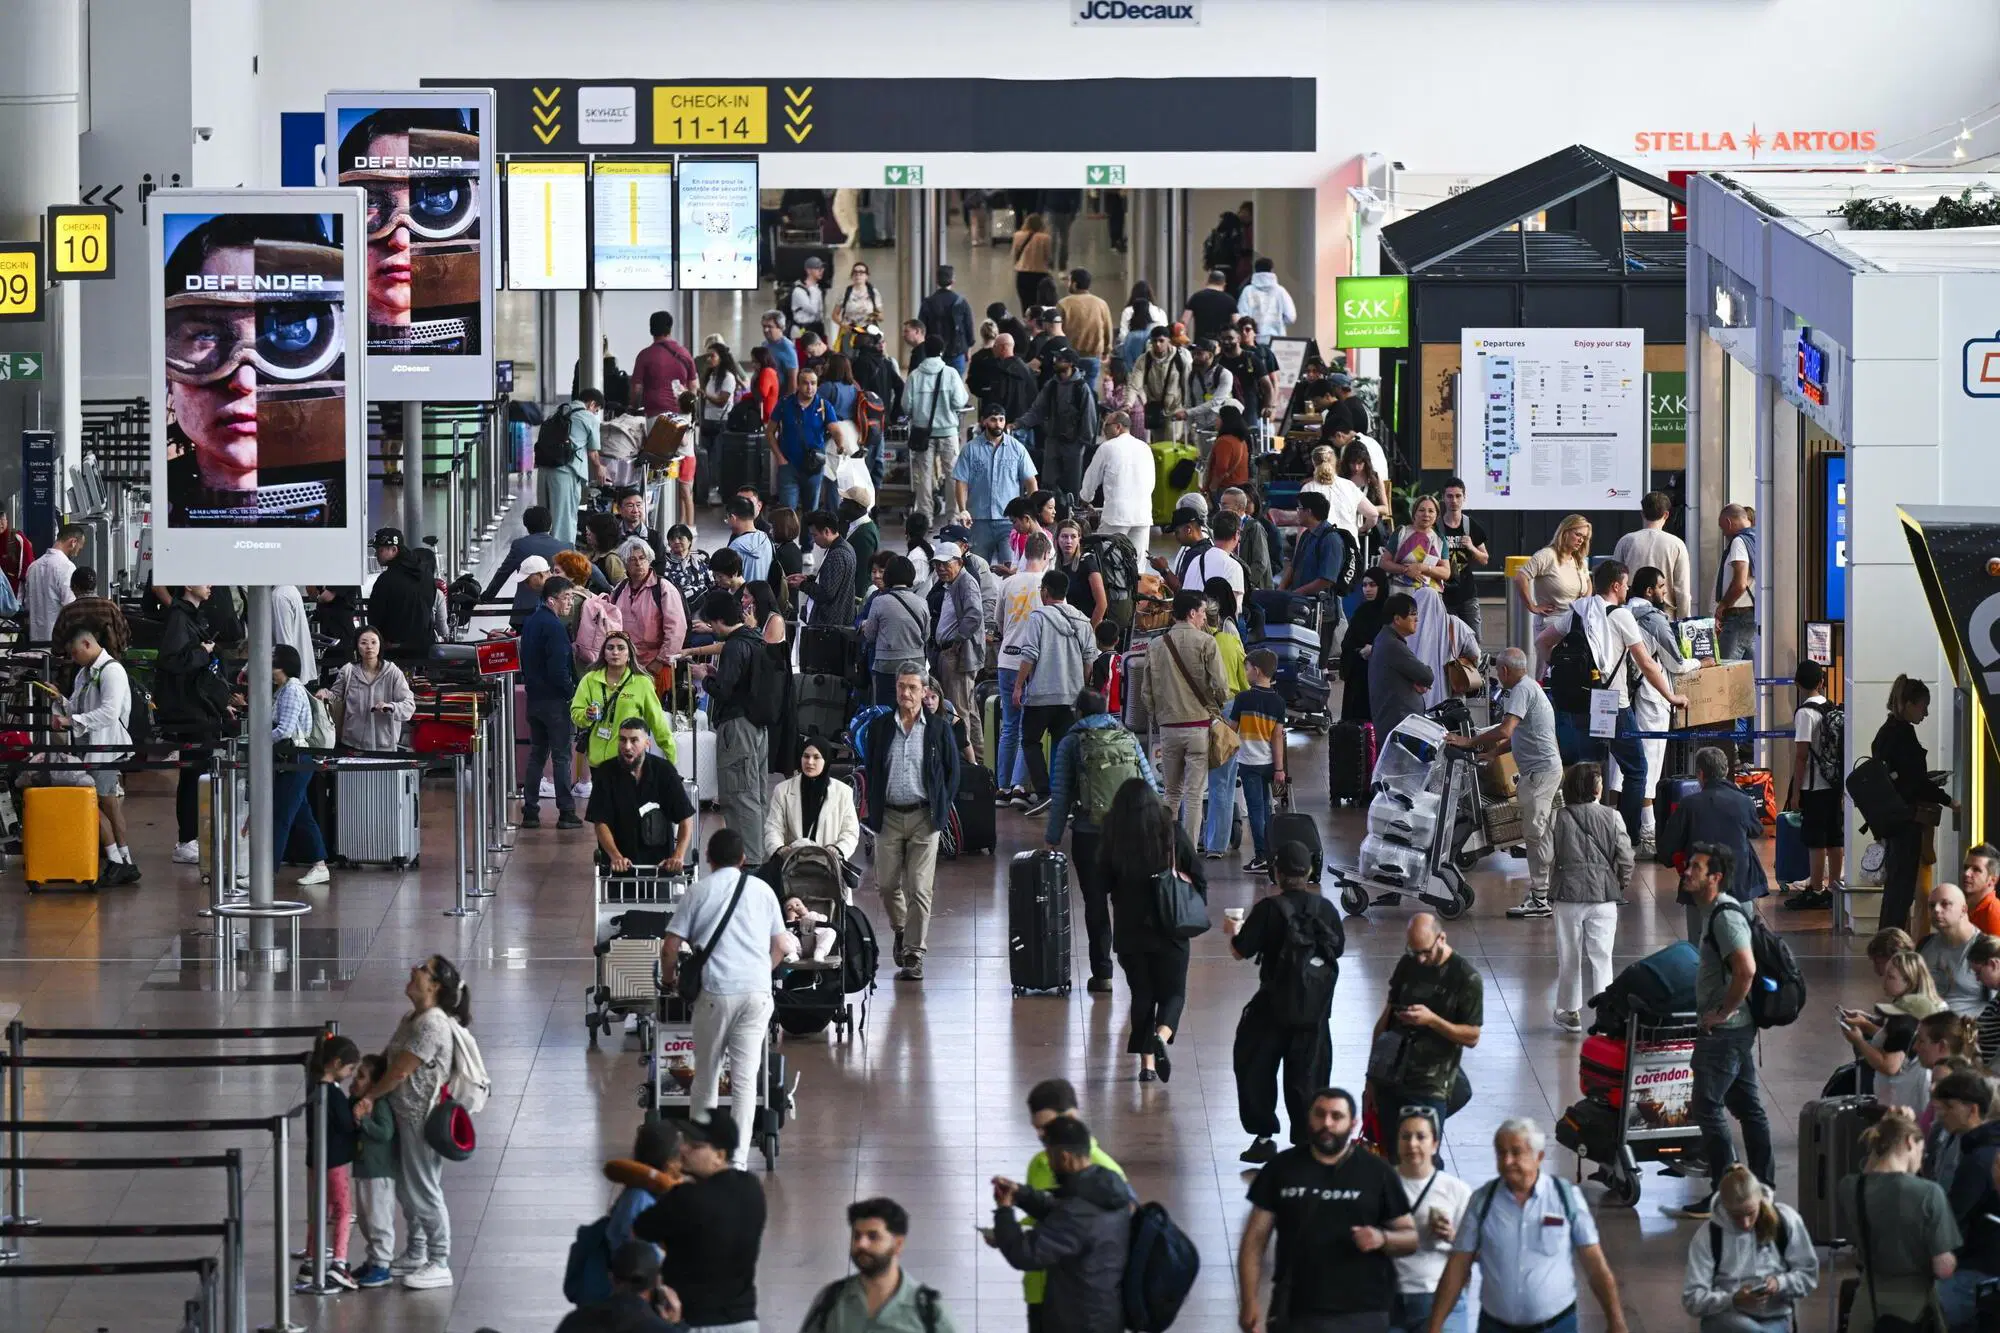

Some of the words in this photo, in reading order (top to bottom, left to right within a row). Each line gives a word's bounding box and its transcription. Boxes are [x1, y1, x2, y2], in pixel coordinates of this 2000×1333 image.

[1080, 1, 1193, 20] JCDecaux
[670, 94, 749, 108] CHECK-IN
[672, 116, 749, 140] 11-14
[1634, 131, 1737, 151] STELLA
[1771, 131, 1877, 151] ARTOIS
[354, 156, 463, 168] DEFENDER
[63, 223, 101, 231] CHECK-IN
[64, 235, 99, 263] 10
[185, 274, 324, 290] DEFENDER
[1483, 340, 1525, 348] Departures
[1574, 340, 1595, 348] Enjoy
[1651, 423, 1674, 431] ature's
[393, 536, 399, 545] S
[664, 1041, 696, 1052] core
[1635, 1068, 1688, 1085] corendon
